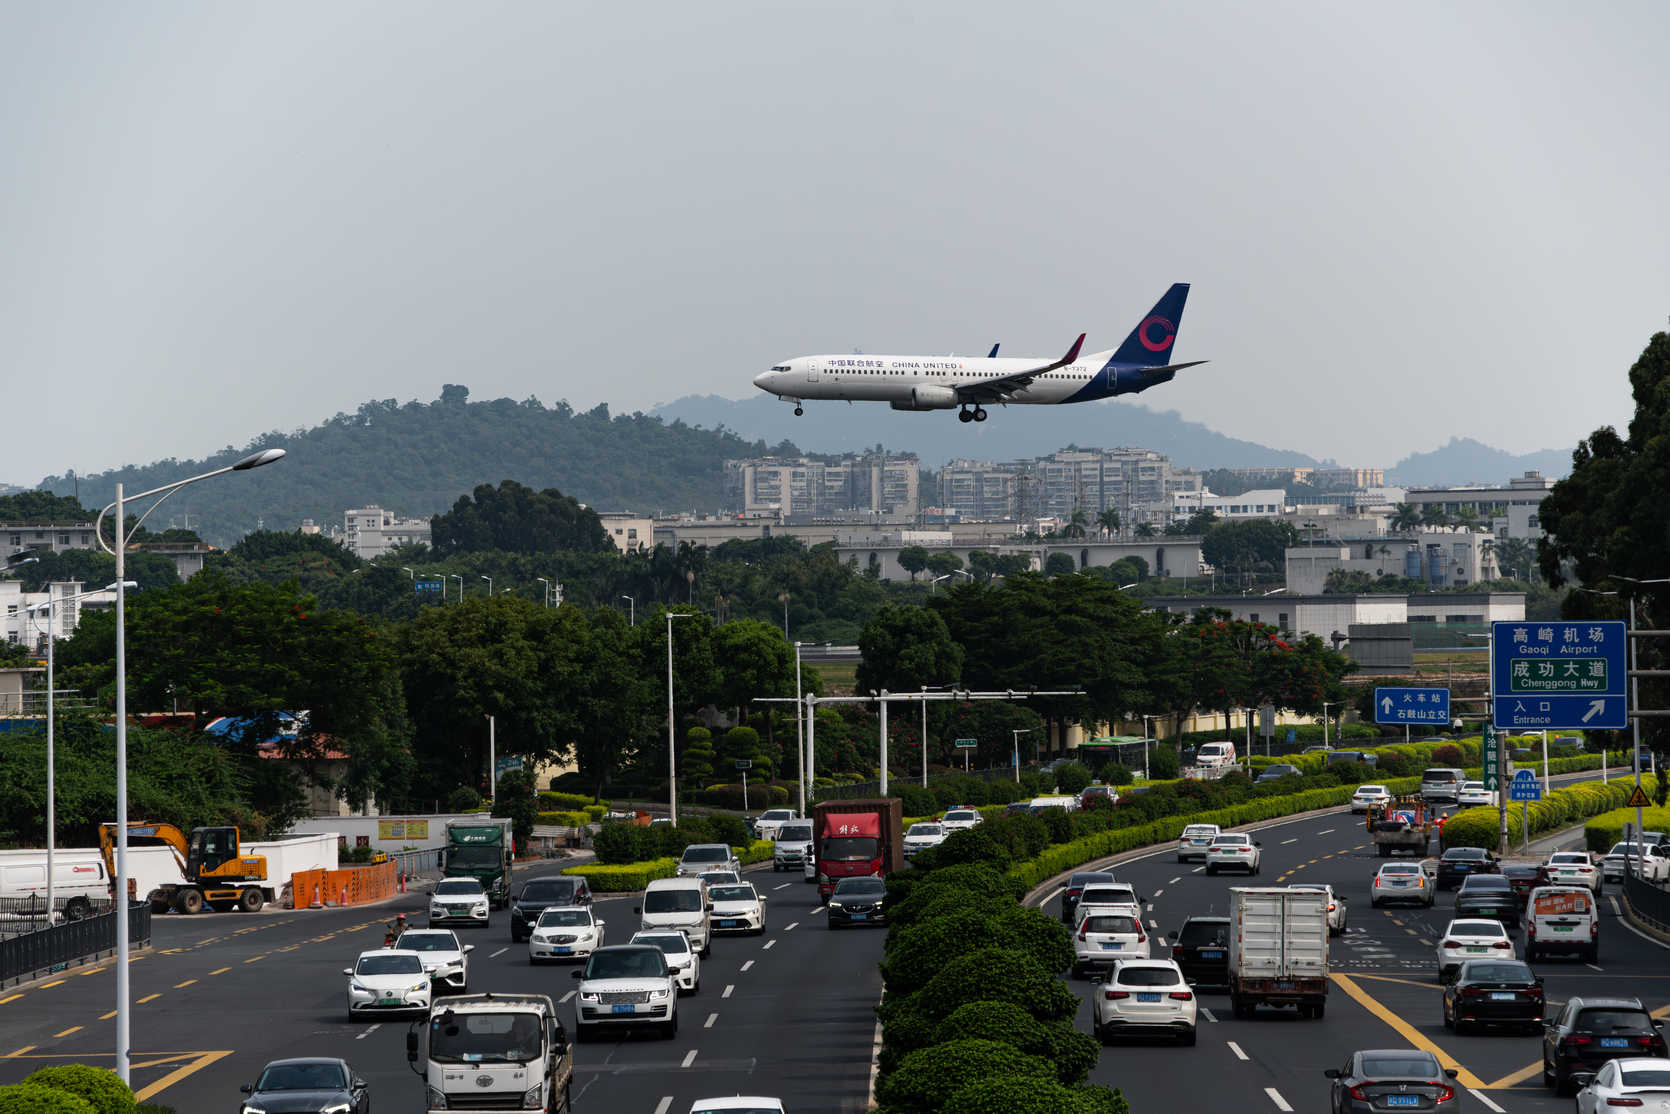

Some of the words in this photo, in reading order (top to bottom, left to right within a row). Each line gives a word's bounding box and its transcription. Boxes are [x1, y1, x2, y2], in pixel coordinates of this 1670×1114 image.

[828, 359, 884, 368] 中国联合航空
[891, 361, 920, 369] CHINA
[1513, 627, 1604, 643] 高崎机场
[1519, 645, 1550, 656] Gaoqi
[1560, 645, 1598, 655] Airport
[1514, 661, 1605, 677] 成功大道
[1521, 679, 1577, 689] Chenggong
[1581, 678, 1599, 688] Hwy
[1403, 692, 1441, 703] 火车站
[1514, 700, 1551, 712] 入口
[1514, 715, 1551, 724] Entrance
